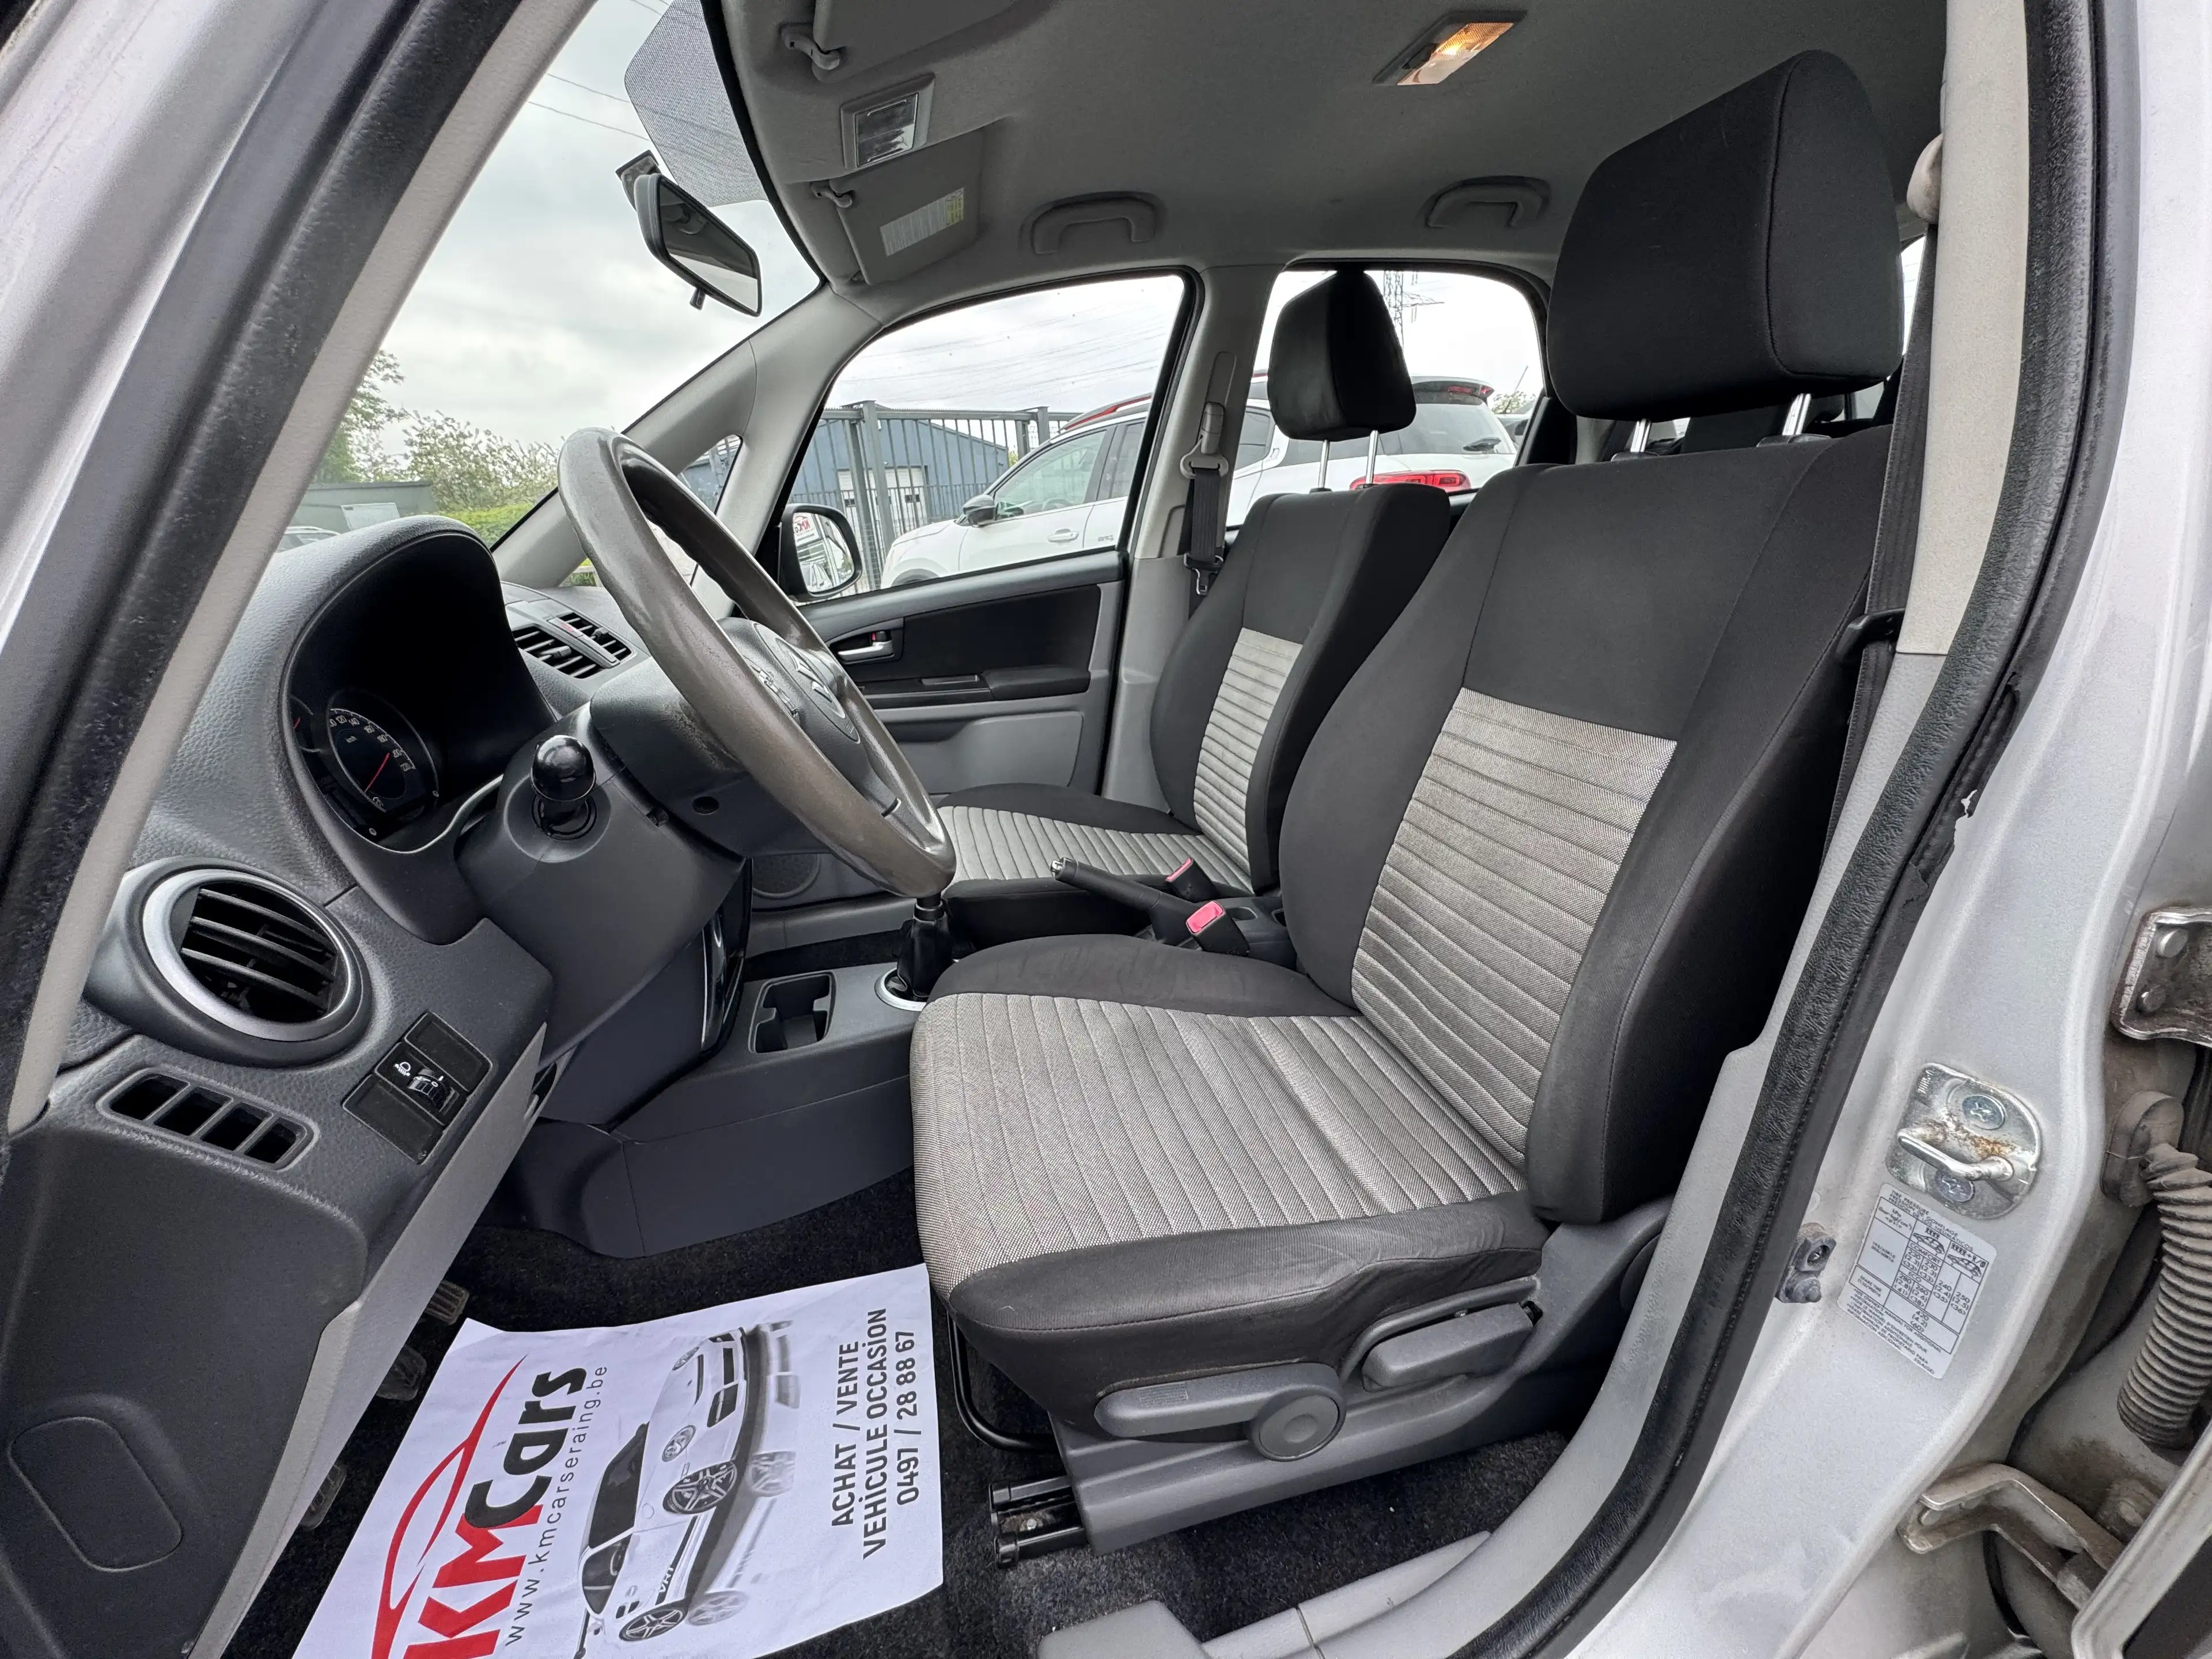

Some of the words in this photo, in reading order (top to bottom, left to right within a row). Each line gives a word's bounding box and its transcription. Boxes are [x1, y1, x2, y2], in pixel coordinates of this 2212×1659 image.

[1889, 1193, 1915, 1212] PRESSION
[1916, 1209, 1925, 1217] DE
[1926, 1215, 1958, 1237] GONFLAGE
[1903, 1196, 1929, 1215] PRESSURE
[1912, 1211, 1920, 1219] DE
[1921, 1217, 1933, 1227] LOS
[1907, 1249, 1921, 1261] 230
[1909, 1242, 1941, 1265] COMFORT
[1924, 1259, 1938, 1272] 230
[1899, 1272, 1912, 1285] 280
[1907, 1270, 1922, 1283] ECO
[1938, 1279, 1952, 1293] 240
[1915, 1283, 1929, 1296] 260
[1955, 1290, 1970, 1304] 250
[1915, 1309, 1929, 1322] 420
[1884, 1310, 1903, 1325] MANUAL
[1903, 1324, 1913, 1333] FOR
[1913, 1331, 1942, 1353] ADDITIONAL
[895, 1331, 915, 1353] 67
[836, 1341, 858, 1415] VENTE
[896, 1358, 916, 1386] 88
[897, 1391, 917, 1419] 28
[831, 1443, 857, 1527] ACHAT
[897, 1448, 919, 1505] 0497
[505, 1366, 607, 1646] www.kmcarseraing.be
